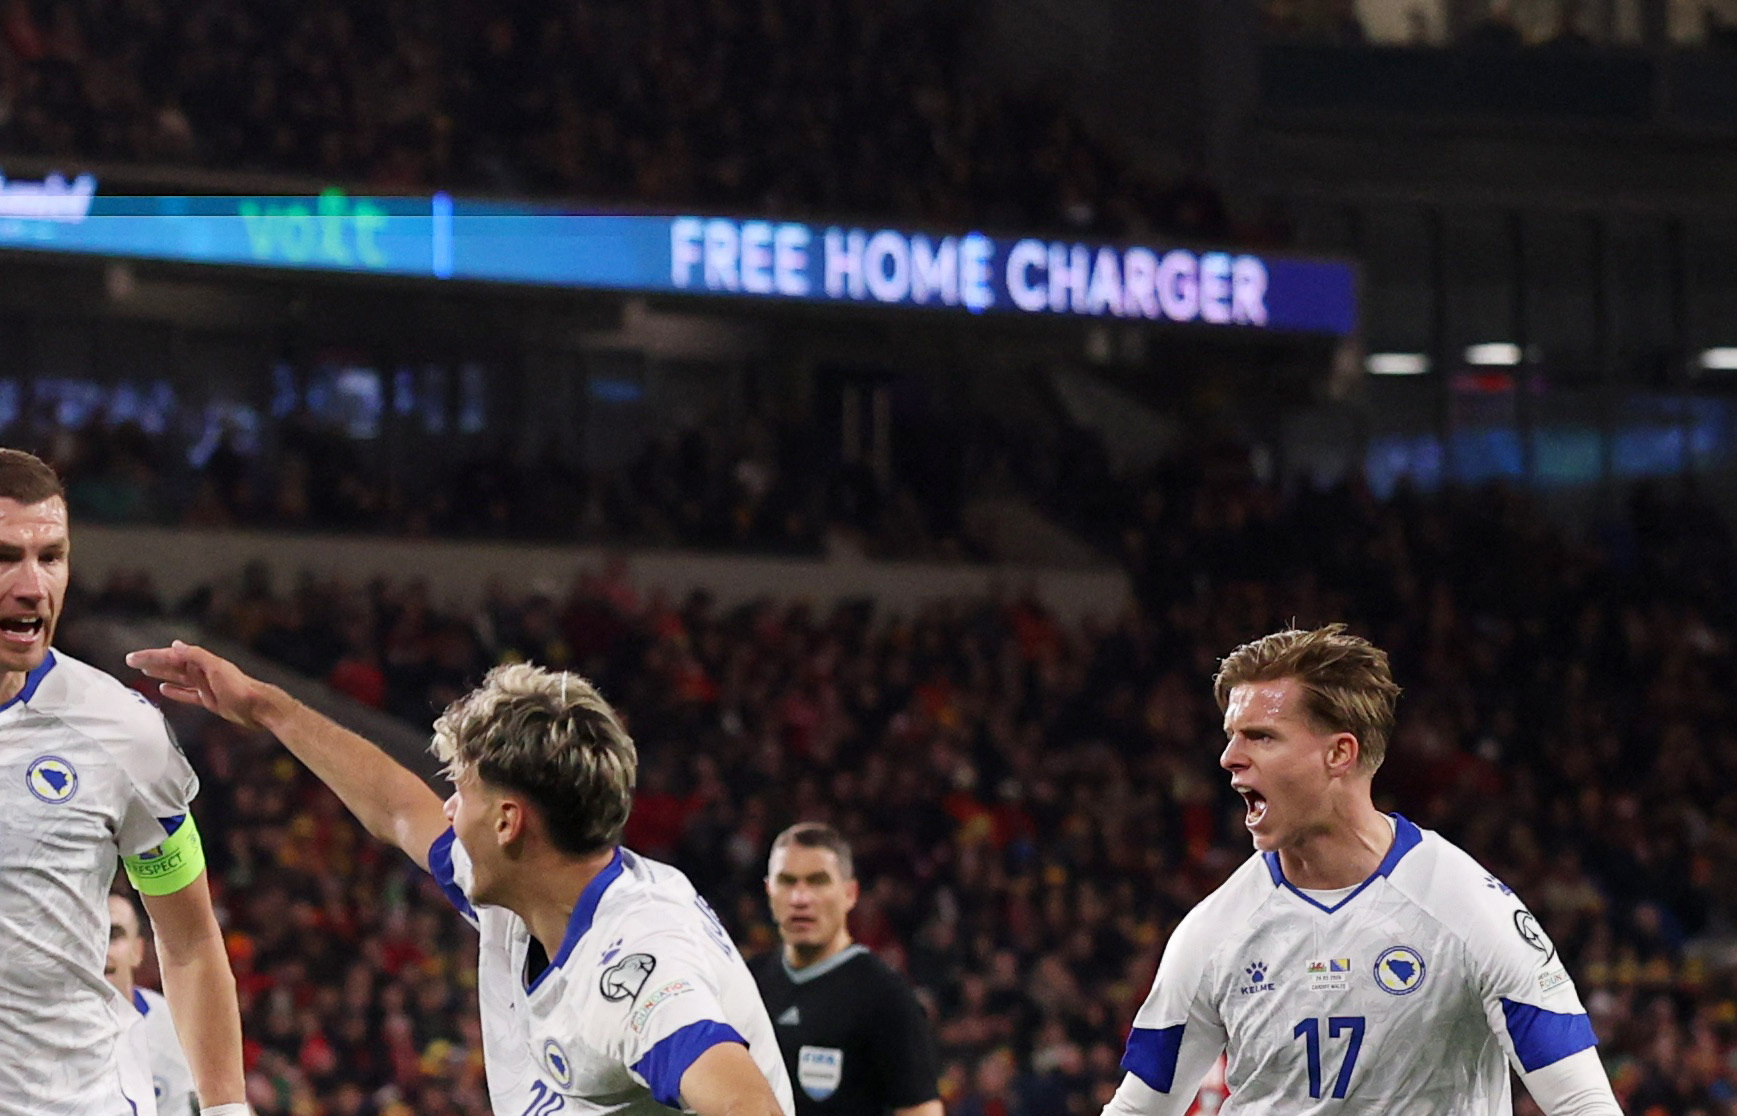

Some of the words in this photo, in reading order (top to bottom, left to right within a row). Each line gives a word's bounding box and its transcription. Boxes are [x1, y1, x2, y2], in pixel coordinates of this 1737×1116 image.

[669, 216, 811, 296] FREE
[825, 226, 994, 312] HOME
[1006, 238, 1268, 327] CHARGER
[1240, 983, 1275, 995] KELME
[1293, 1016, 1366, 1099] 17
